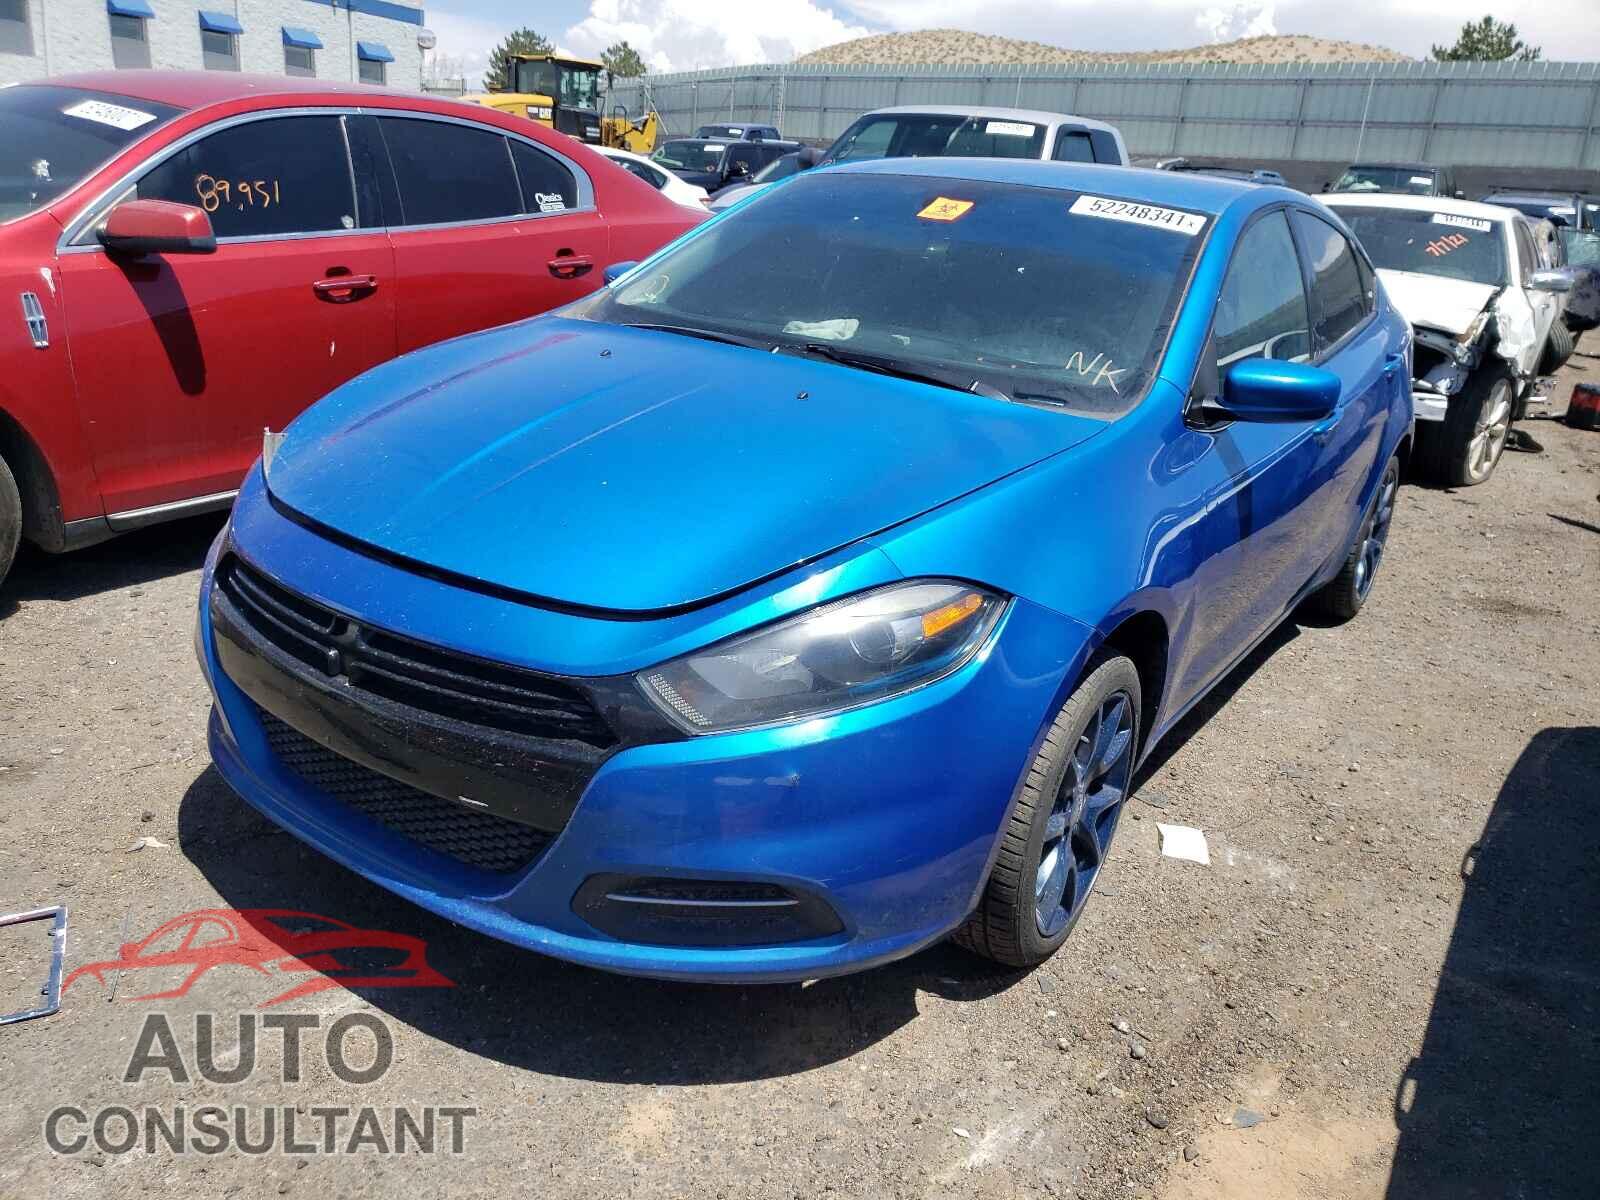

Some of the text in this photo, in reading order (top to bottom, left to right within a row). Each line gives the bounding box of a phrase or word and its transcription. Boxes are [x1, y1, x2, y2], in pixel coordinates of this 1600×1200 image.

[197, 174, 280, 212] 89,951
[1089, 199, 1186, 226] 52248341
[1065, 351, 1127, 395] NK
